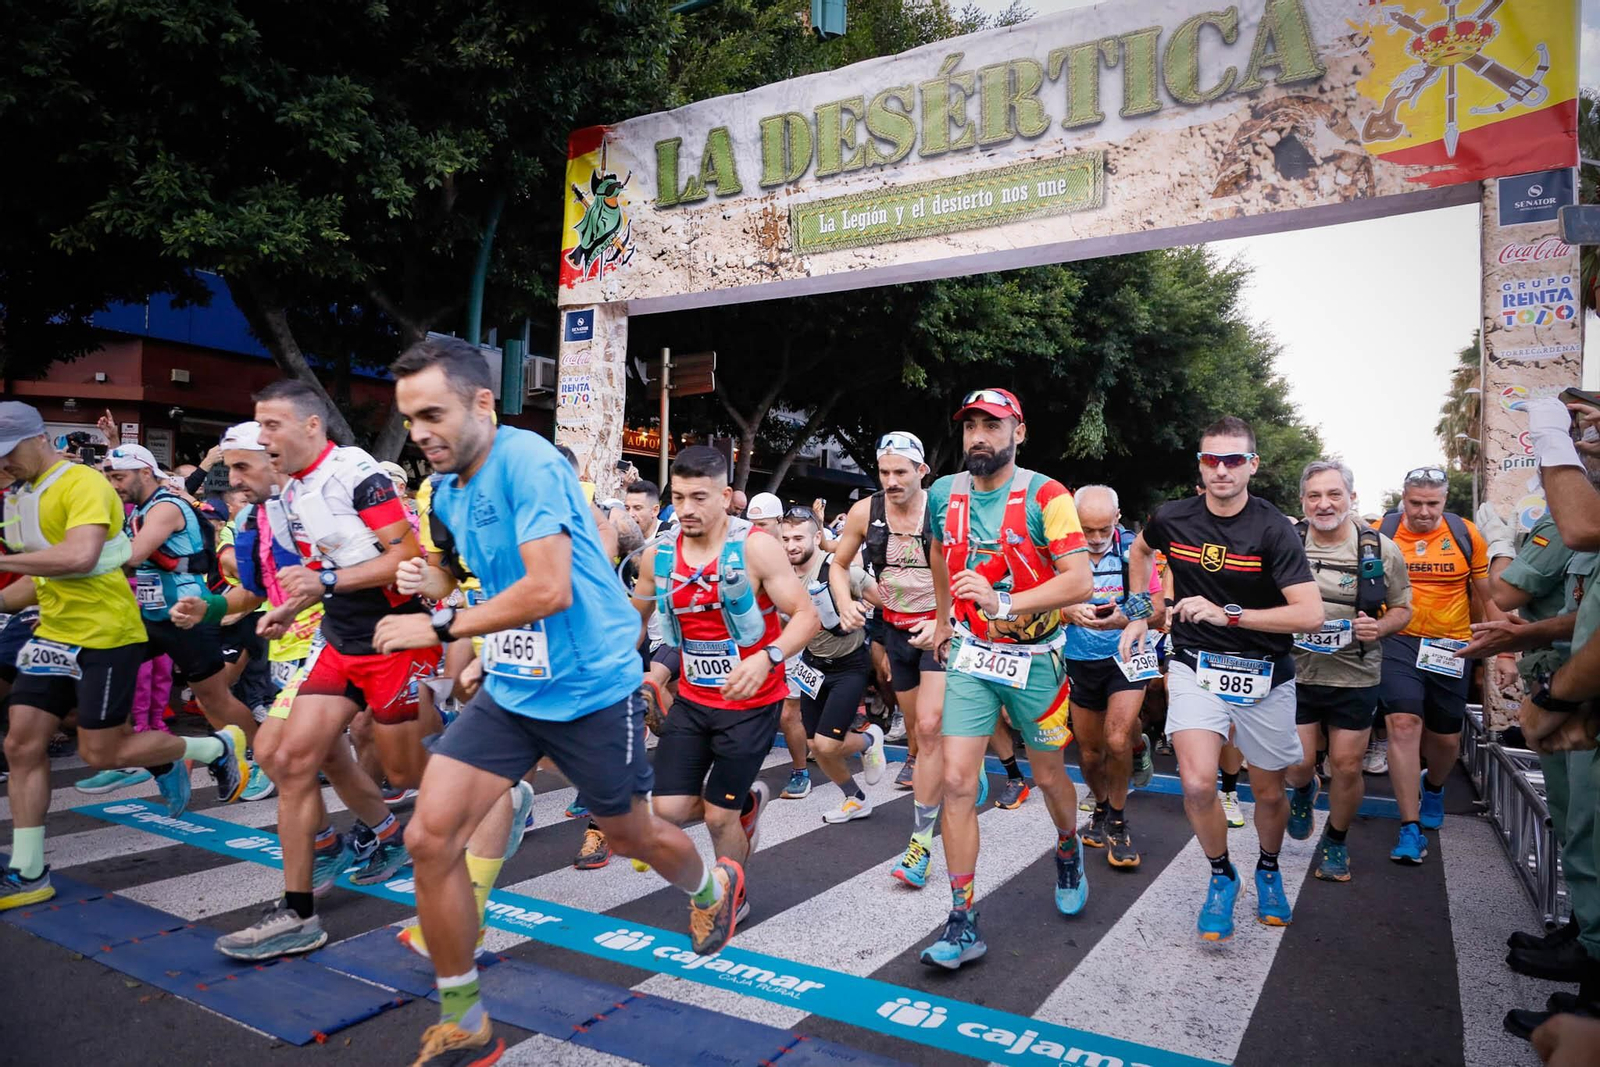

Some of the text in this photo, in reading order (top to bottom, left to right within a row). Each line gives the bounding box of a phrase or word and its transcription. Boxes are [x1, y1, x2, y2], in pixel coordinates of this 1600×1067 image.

[655, 0, 1327, 208] LA DESÉRTICA
[819, 178, 1067, 233] La Legión y el desierto nos une
[1514, 197, 1557, 209] SENATOR
[1499, 237, 1570, 264] Coca-Cola
[1502, 276, 1571, 291] GRUPO
[1503, 287, 1574, 308] RENTA
[1502, 304, 1574, 326] TODO
[561, 375, 591, 383] GRUPO
[561, 383, 591, 394] RENTA
[561, 393, 590, 405] TODO
[494, 634, 535, 661] 1466
[1305, 633, 1340, 646] 3341
[32, 648, 71, 667] 2082
[694, 659, 732, 675] 1008
[974, 651, 1019, 677] 3405
[797, 665, 817, 688] 3488
[1219, 675, 1254, 694] 985
[652, 946, 826, 993] cajamar
[718, 973, 801, 1000] CAJA RURAL
[957, 1021, 1158, 1067] cajam
